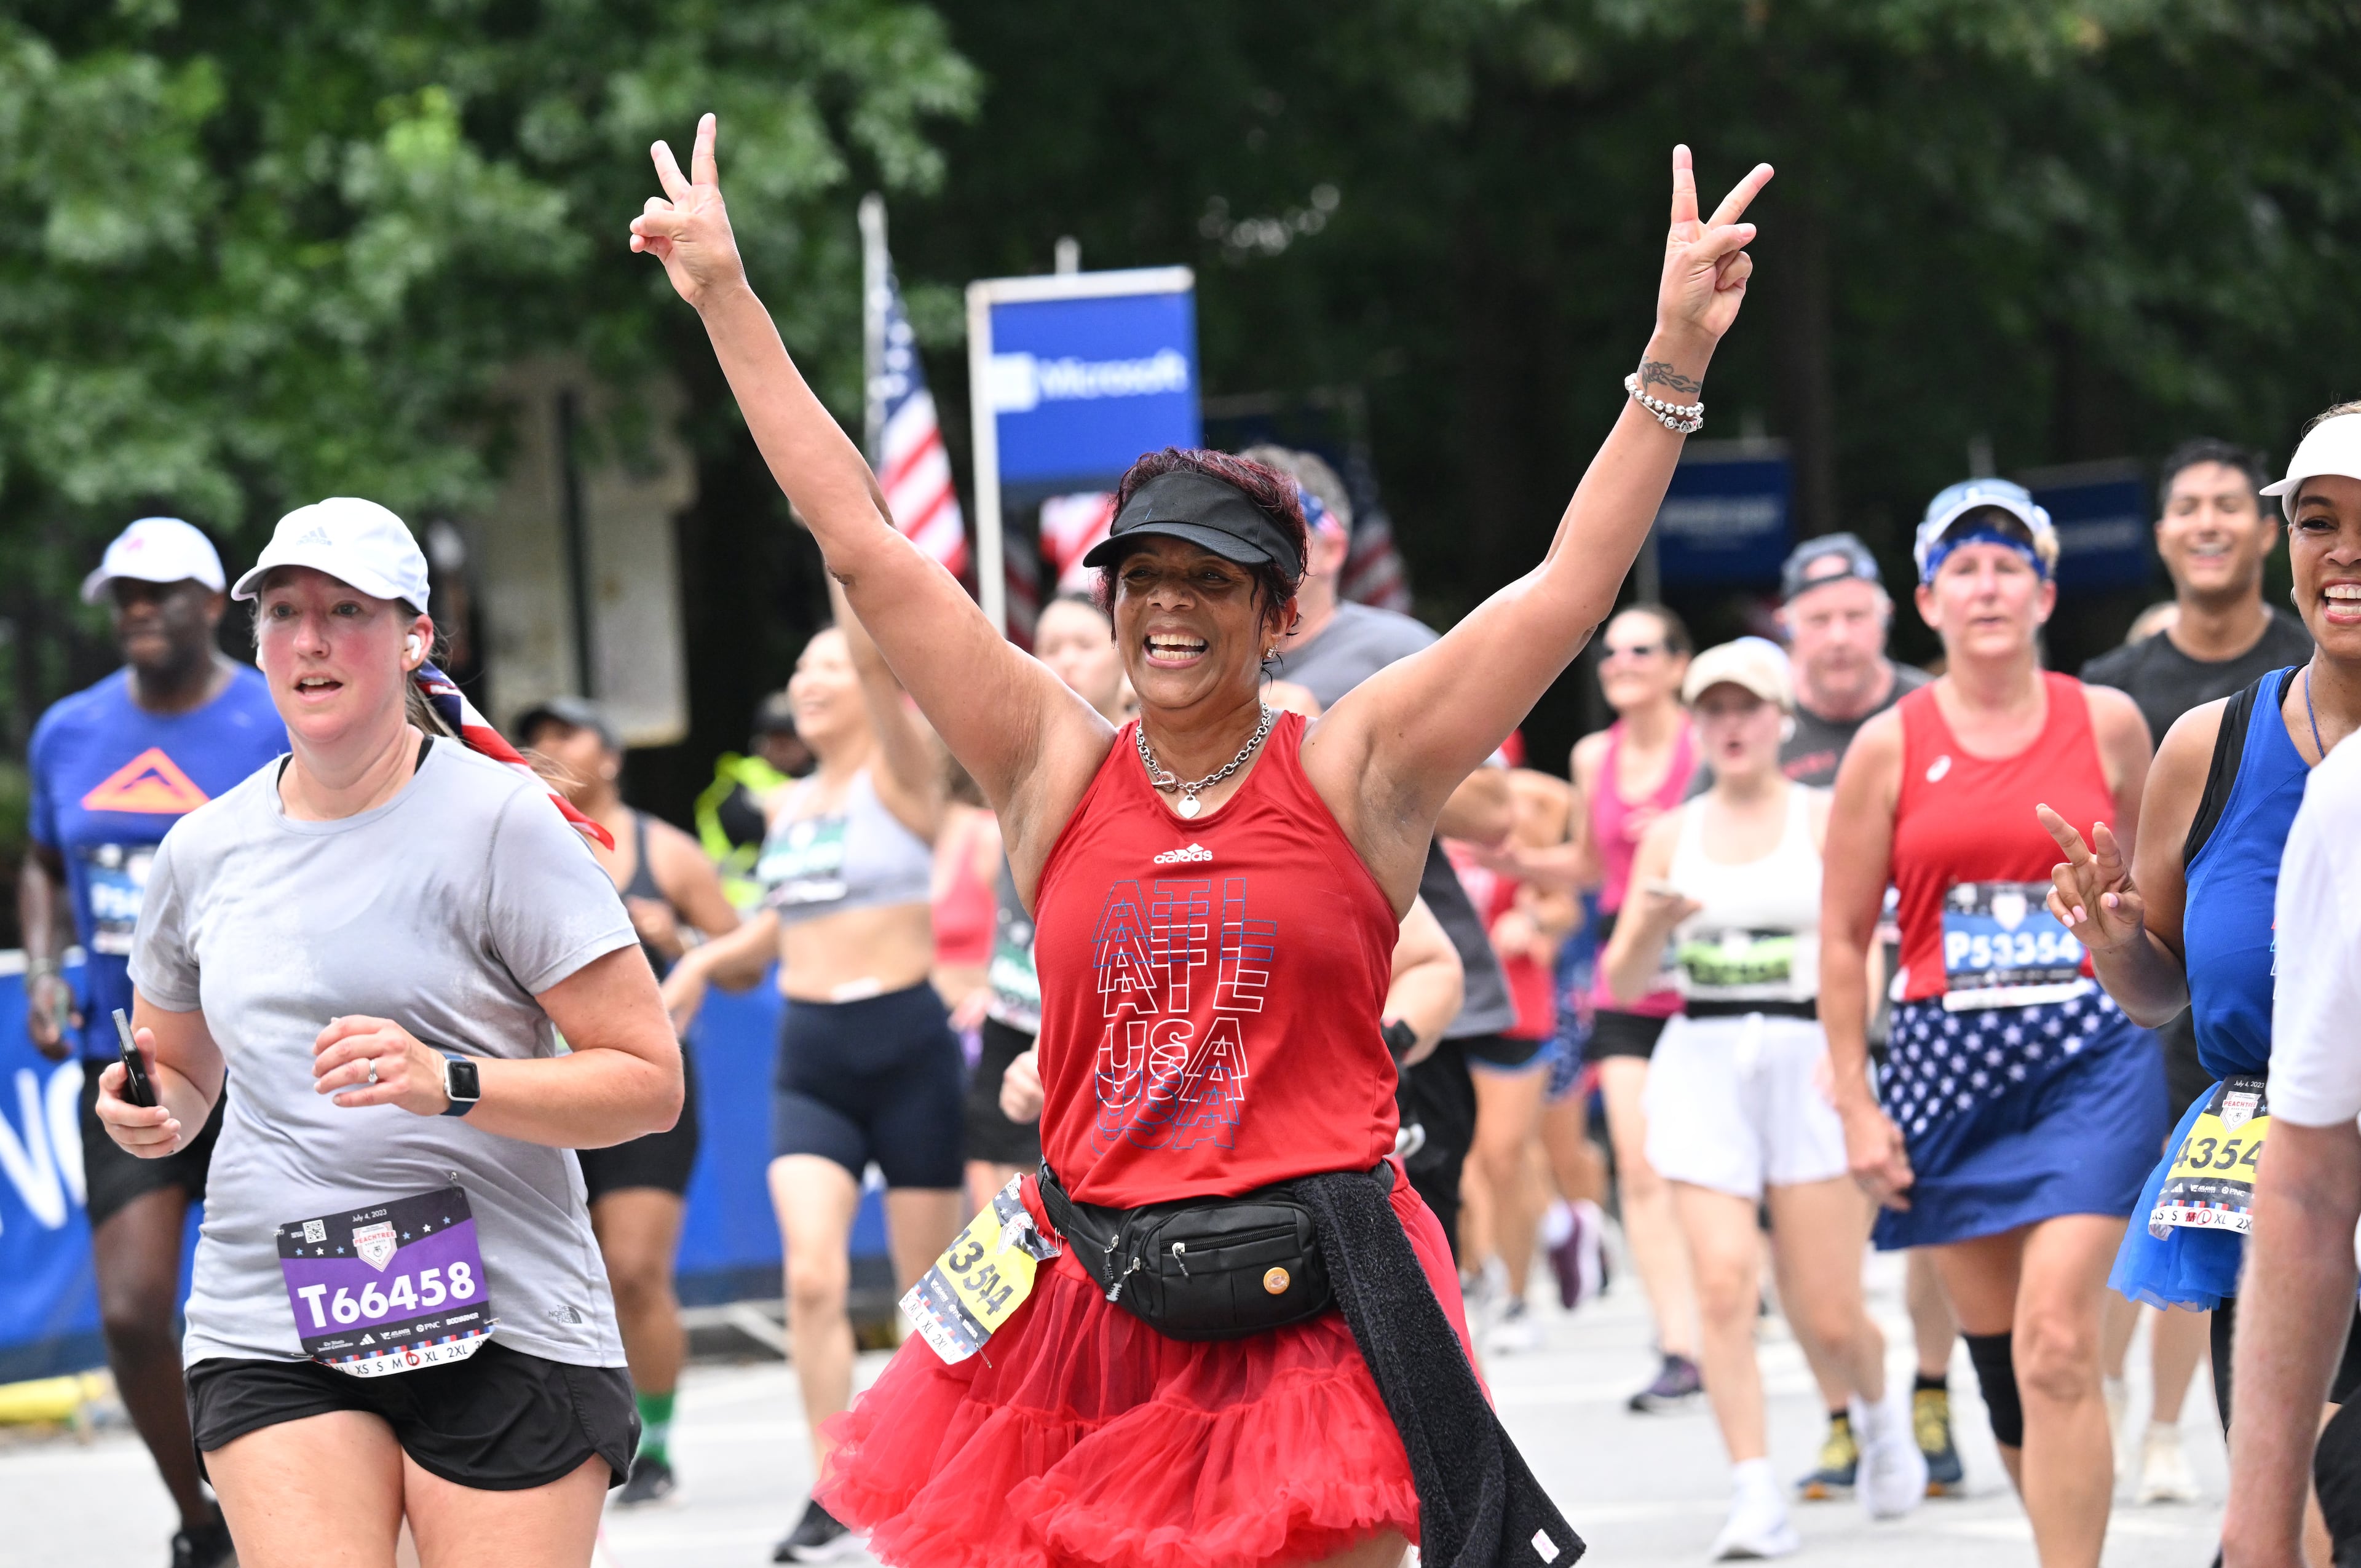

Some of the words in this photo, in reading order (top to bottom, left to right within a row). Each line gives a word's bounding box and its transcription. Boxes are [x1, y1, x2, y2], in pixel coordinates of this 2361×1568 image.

[1042, 348, 1187, 400] Microsoft
[1153, 846, 1213, 864] adidas
[1945, 931, 2080, 970] P53354
[2229, 1189, 2245, 1197] PNC
[352, 1214, 363, 1222] July
[371, 1208, 387, 1218] 2023
[2172, 1210, 2178, 1221] S
[2202, 1212, 2207, 1224] L
[2214, 1214, 2227, 1225] XL
[2236, 1218, 2253, 1231] 2X
[354, 1231, 395, 1244] PEACHTREE
[297, 1261, 475, 1328] T66458
[903, 1294, 912, 1303] S
[908, 1303, 919, 1314] M
[916, 1312, 923, 1321] L
[922, 1320, 934, 1334] XL
[424, 1321, 441, 1331] PNC
[355, 1364, 369, 1374] XS
[377, 1361, 384, 1372] S
[392, 1358, 403, 1369] M
[425, 1351, 438, 1362] XL
[447, 1345, 468, 1358] 2XL
